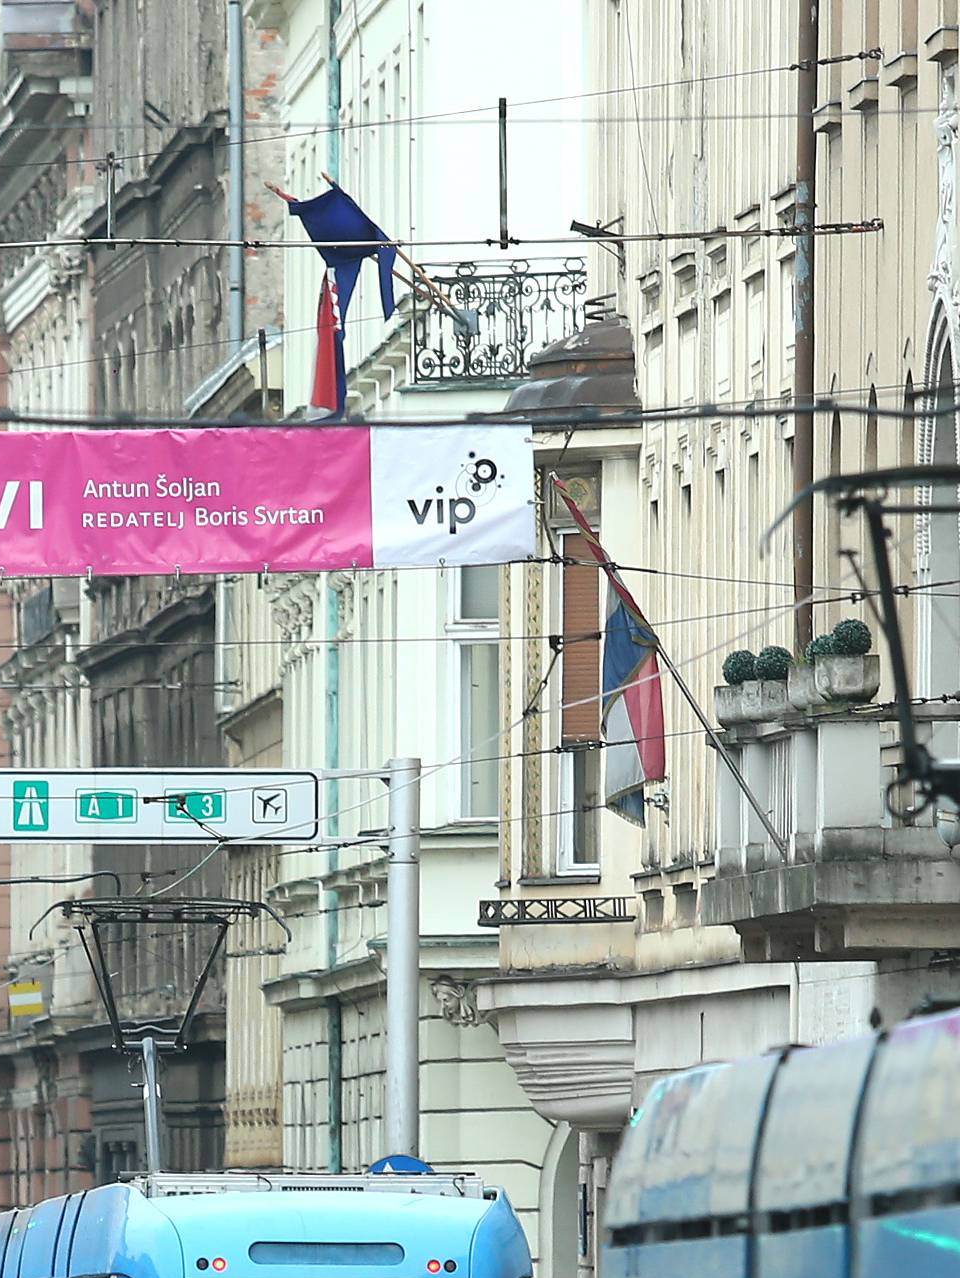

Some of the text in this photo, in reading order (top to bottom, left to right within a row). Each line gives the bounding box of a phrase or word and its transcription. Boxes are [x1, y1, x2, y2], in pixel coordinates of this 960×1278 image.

[83, 474, 221, 502] Antun Šoljan
[82, 504, 324, 530] REDATELJ Boris Svrtan
[406, 485, 477, 535] vip
